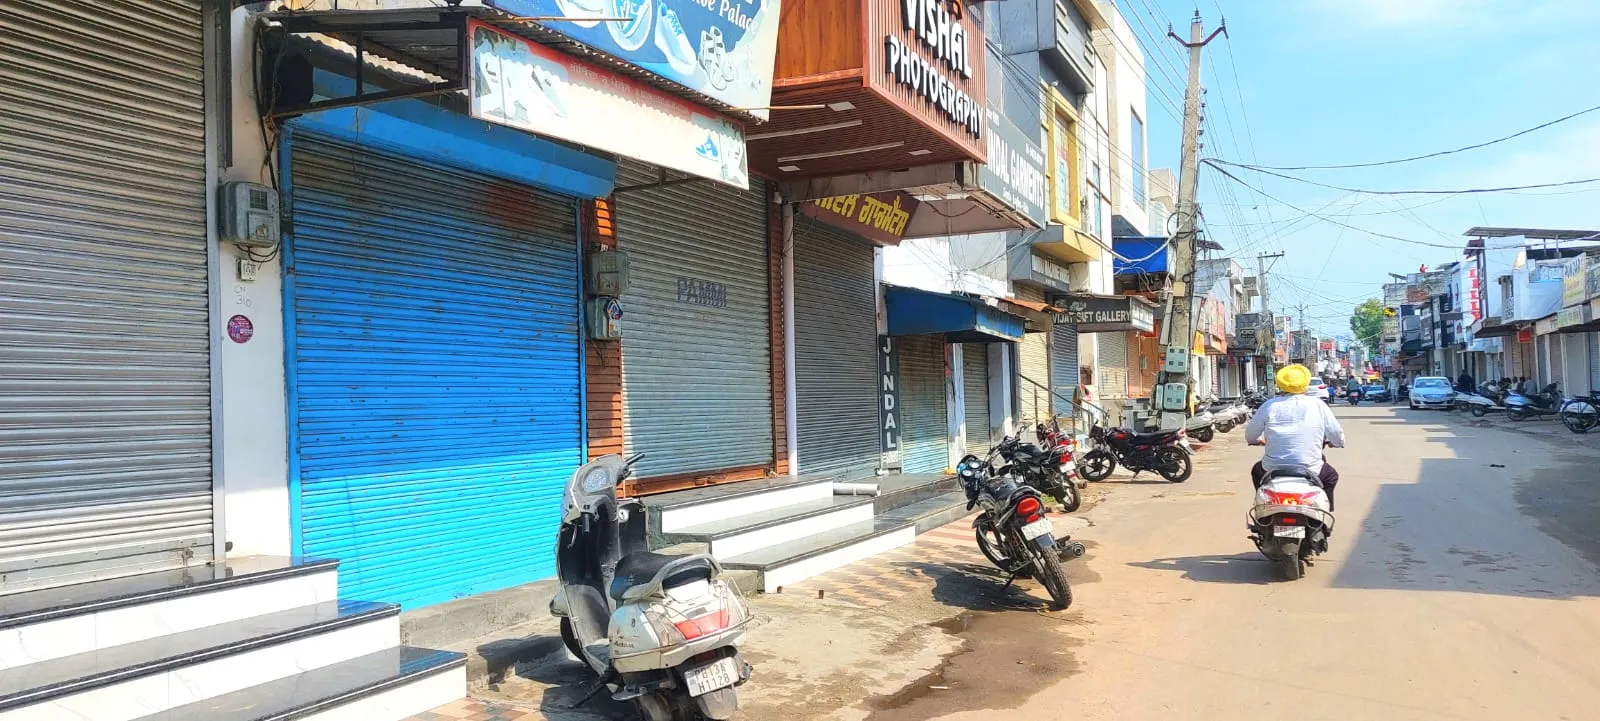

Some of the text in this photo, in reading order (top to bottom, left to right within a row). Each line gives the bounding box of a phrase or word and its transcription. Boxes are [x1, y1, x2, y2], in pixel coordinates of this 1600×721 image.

[902, 0, 973, 79] VISHAL
[886, 34, 983, 140] PHOTOGRAPHY
[1010, 148, 1044, 210] GARMENTS
[677, 278, 727, 308] PAMMI
[1095, 310, 1131, 322] GALLERY
[882, 337, 897, 449] JINDAL
[694, 662, 727, 681] PB13A
[697, 673, 730, 693] H1128
